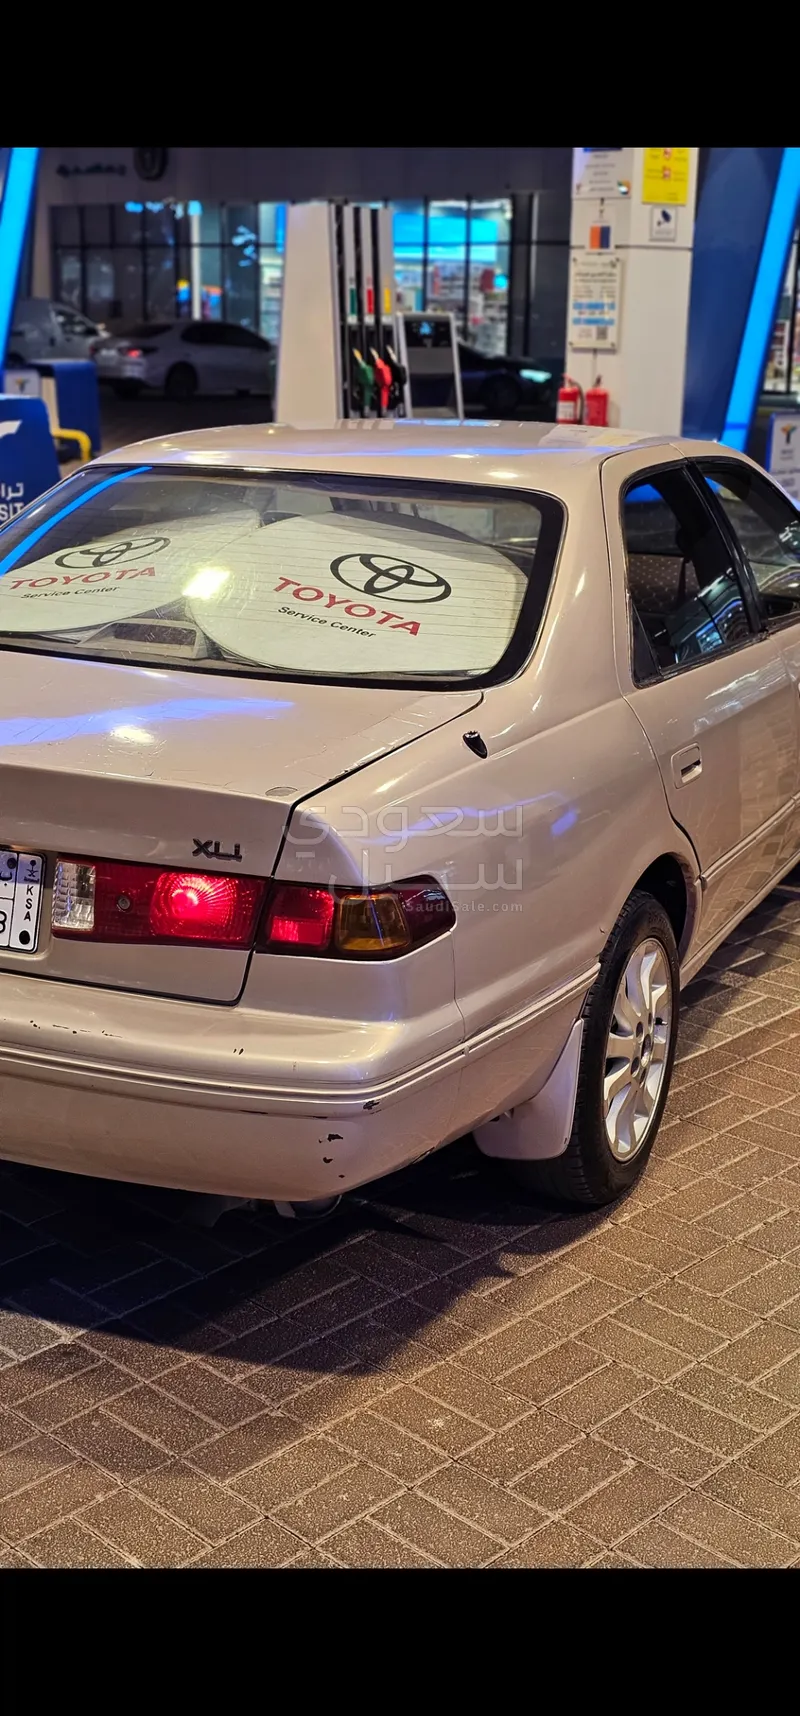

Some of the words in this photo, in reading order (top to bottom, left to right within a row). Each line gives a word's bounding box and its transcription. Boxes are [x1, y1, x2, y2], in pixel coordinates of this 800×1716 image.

[9, 566, 156, 590] TOYOTA
[21, 590, 70, 599] Service
[79, 586, 120, 595] Center
[273, 576, 421, 637] TOYOTA
[278, 606, 327, 625] Service
[330, 621, 377, 638] Center
[23, 884, 34, 922] KSA
